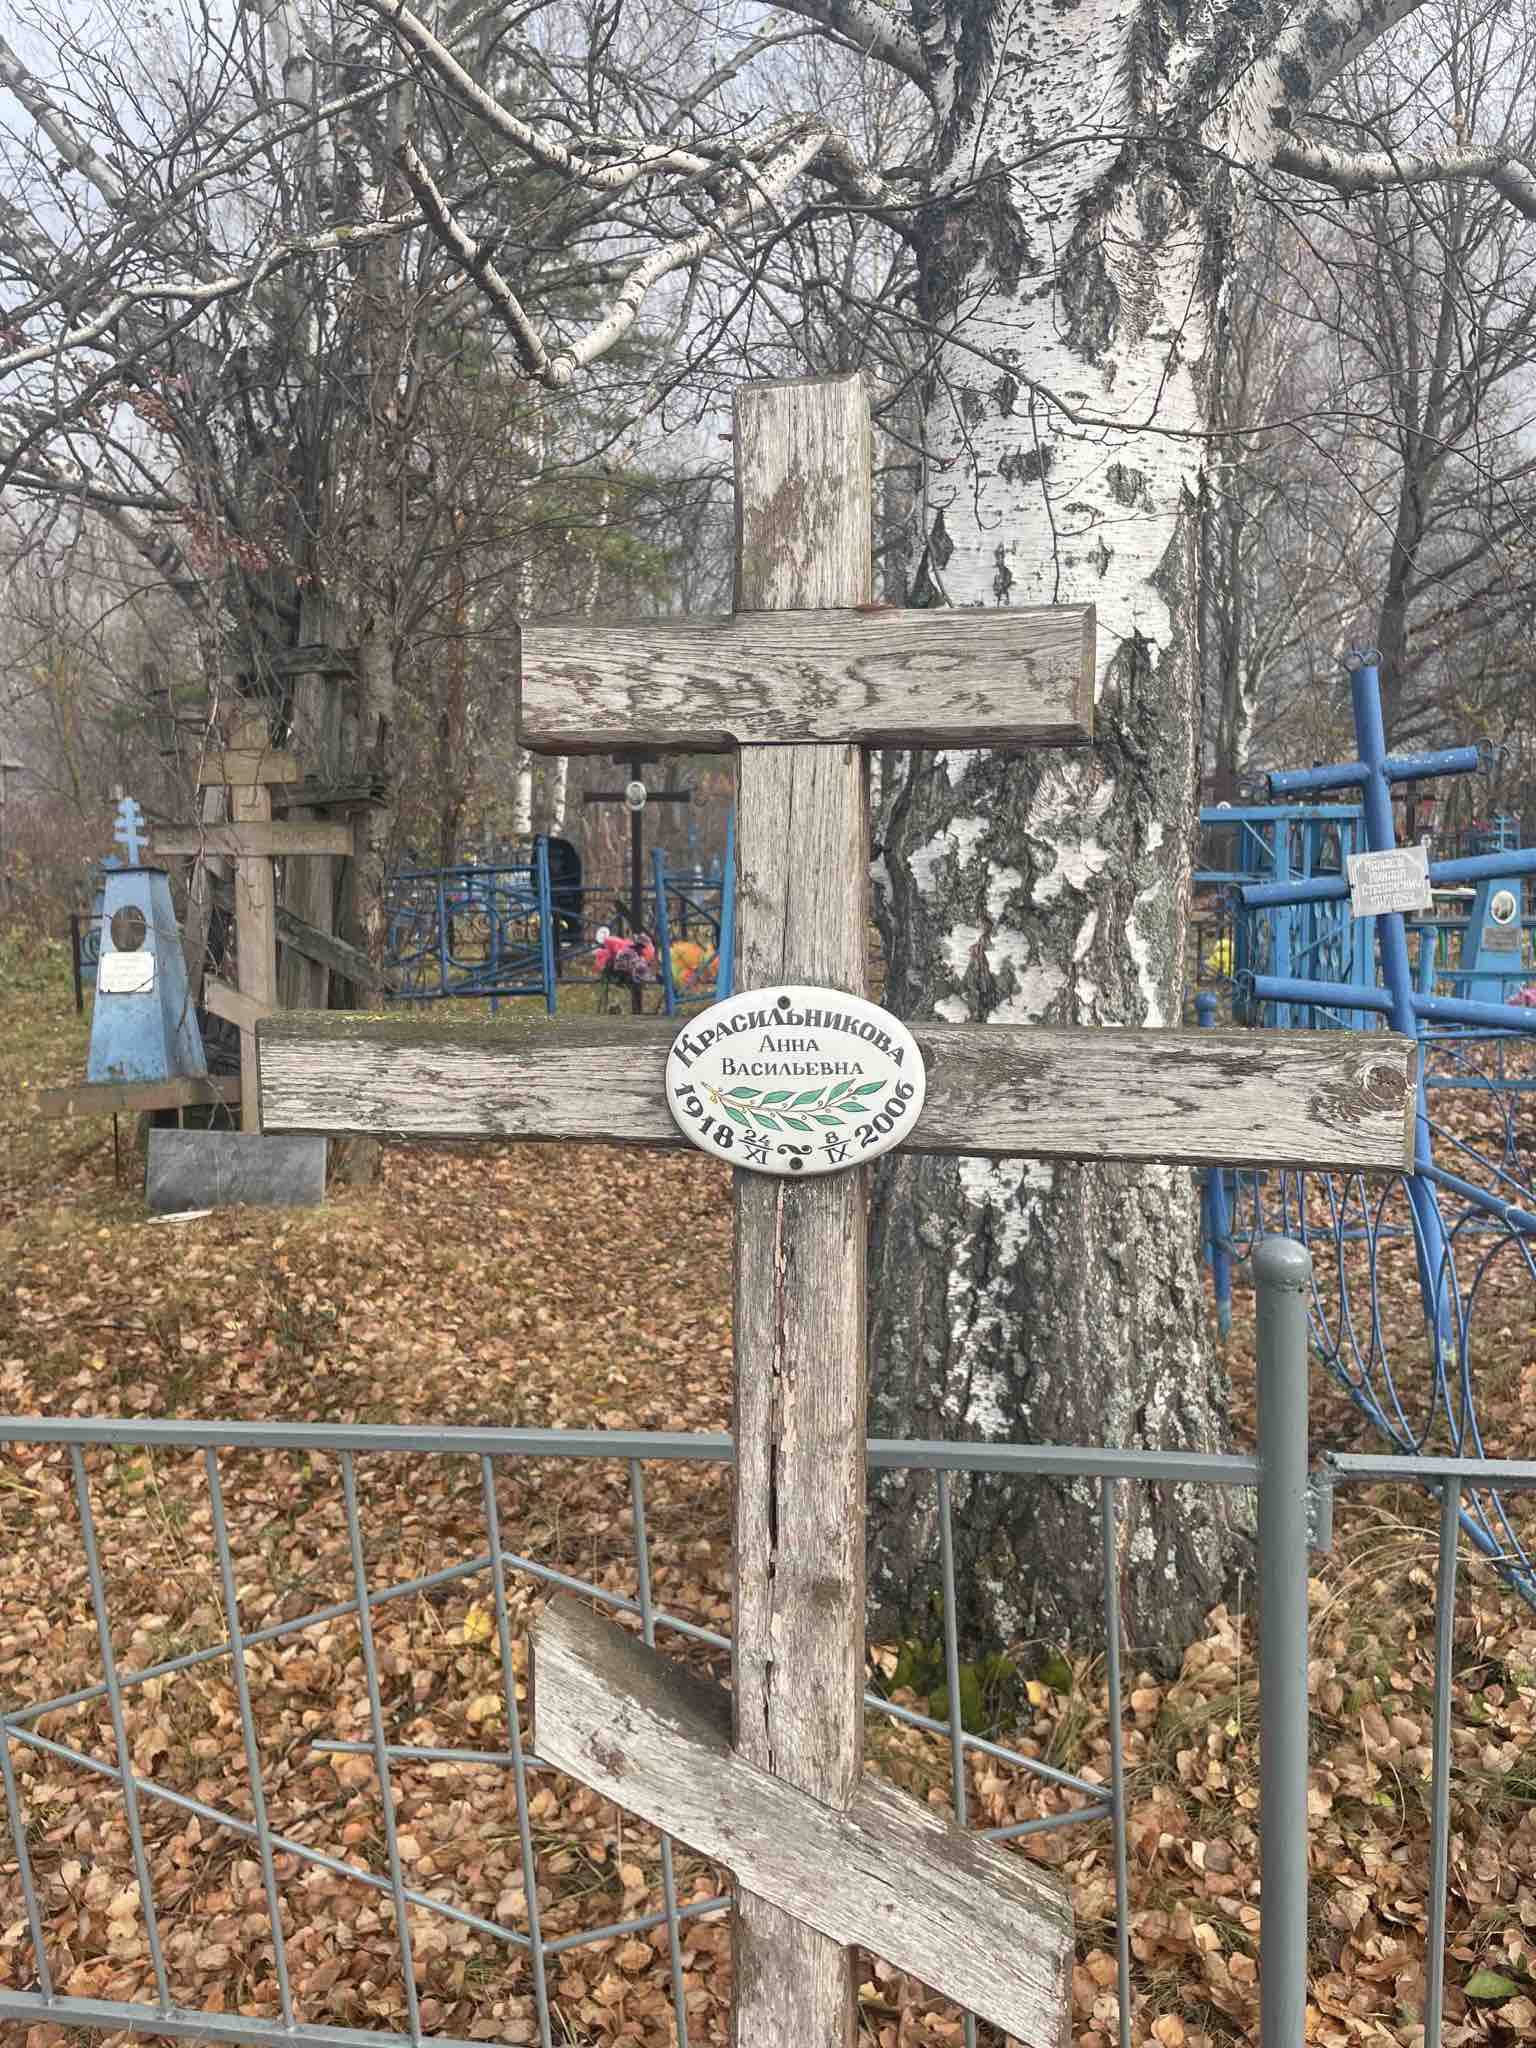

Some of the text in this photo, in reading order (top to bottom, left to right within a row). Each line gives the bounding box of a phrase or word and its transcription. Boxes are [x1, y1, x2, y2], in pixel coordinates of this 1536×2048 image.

[674, 1082, 735, 1149] 1918
[855, 1079, 915, 1149] 2006
[743, 1129, 771, 1147] 24
[825, 1131, 839, 1144] 8
